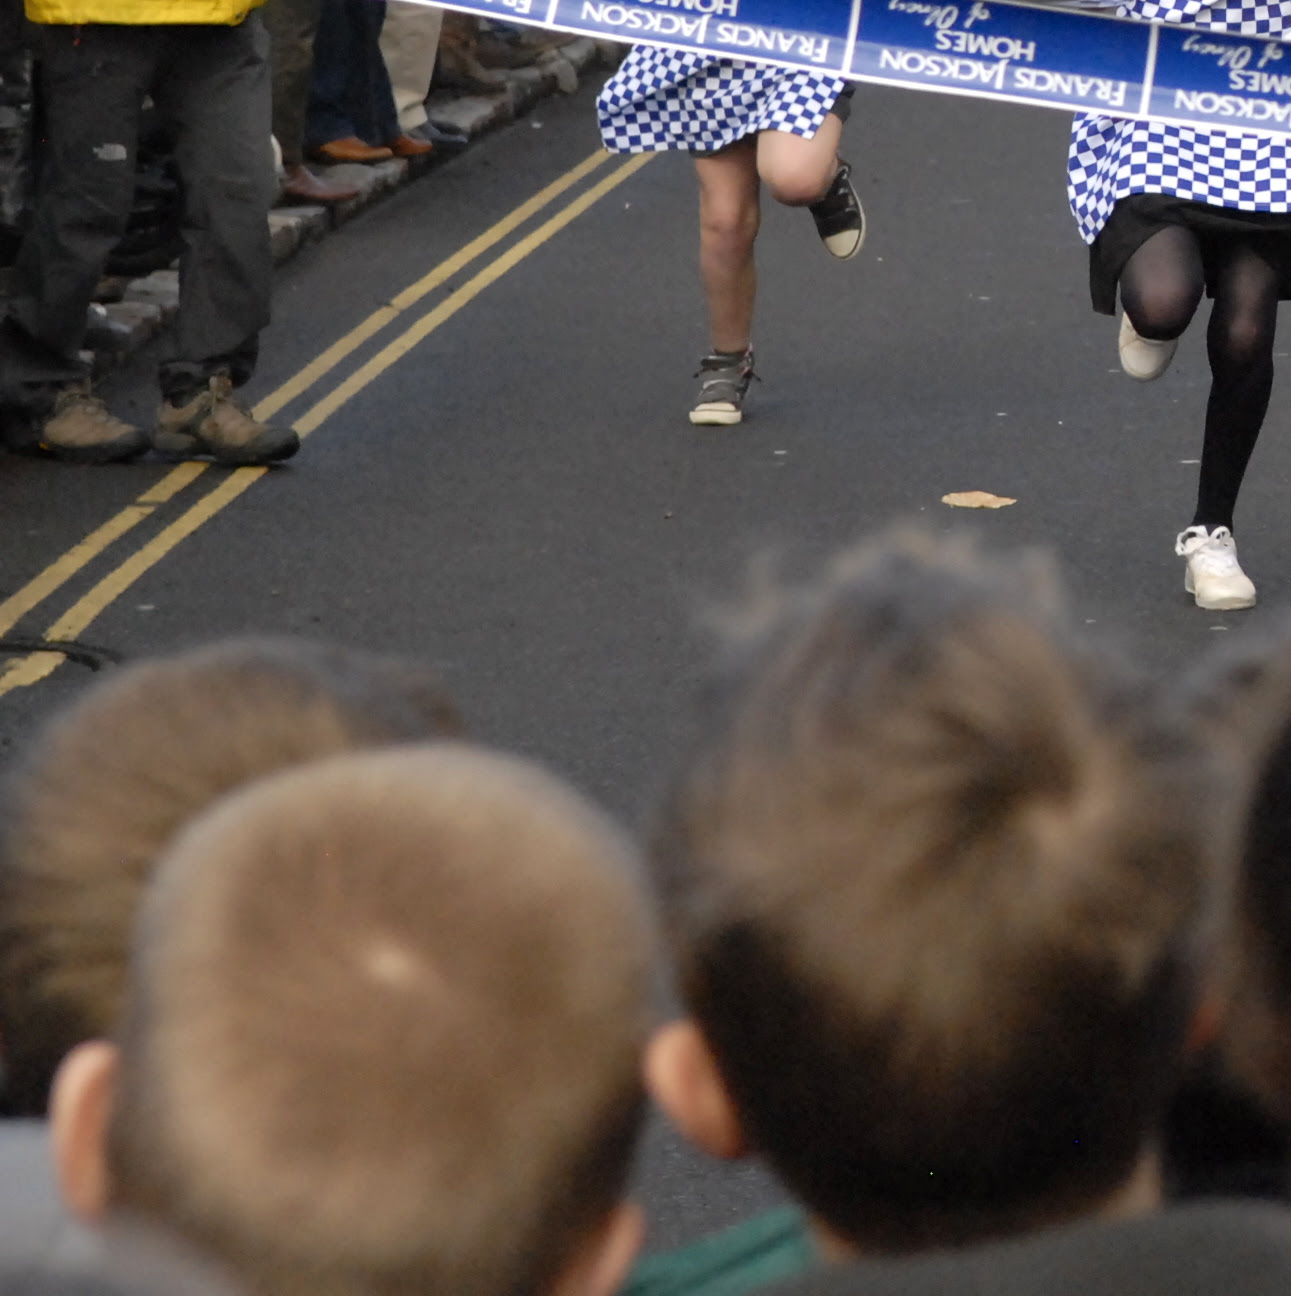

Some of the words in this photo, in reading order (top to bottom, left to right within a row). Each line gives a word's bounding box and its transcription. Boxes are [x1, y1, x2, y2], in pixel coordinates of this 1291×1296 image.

[580, 0, 712, 44] JACKSON
[963, 1, 990, 27] of
[716, 23, 830, 63] FRANCIS
[935, 31, 1035, 61] HOMES
[1181, 34, 1251, 71] Olney
[1257, 42, 1283, 68] of
[879, 48, 1009, 90] JACKSON
[1013, 67, 1127, 106] FRANCIS
